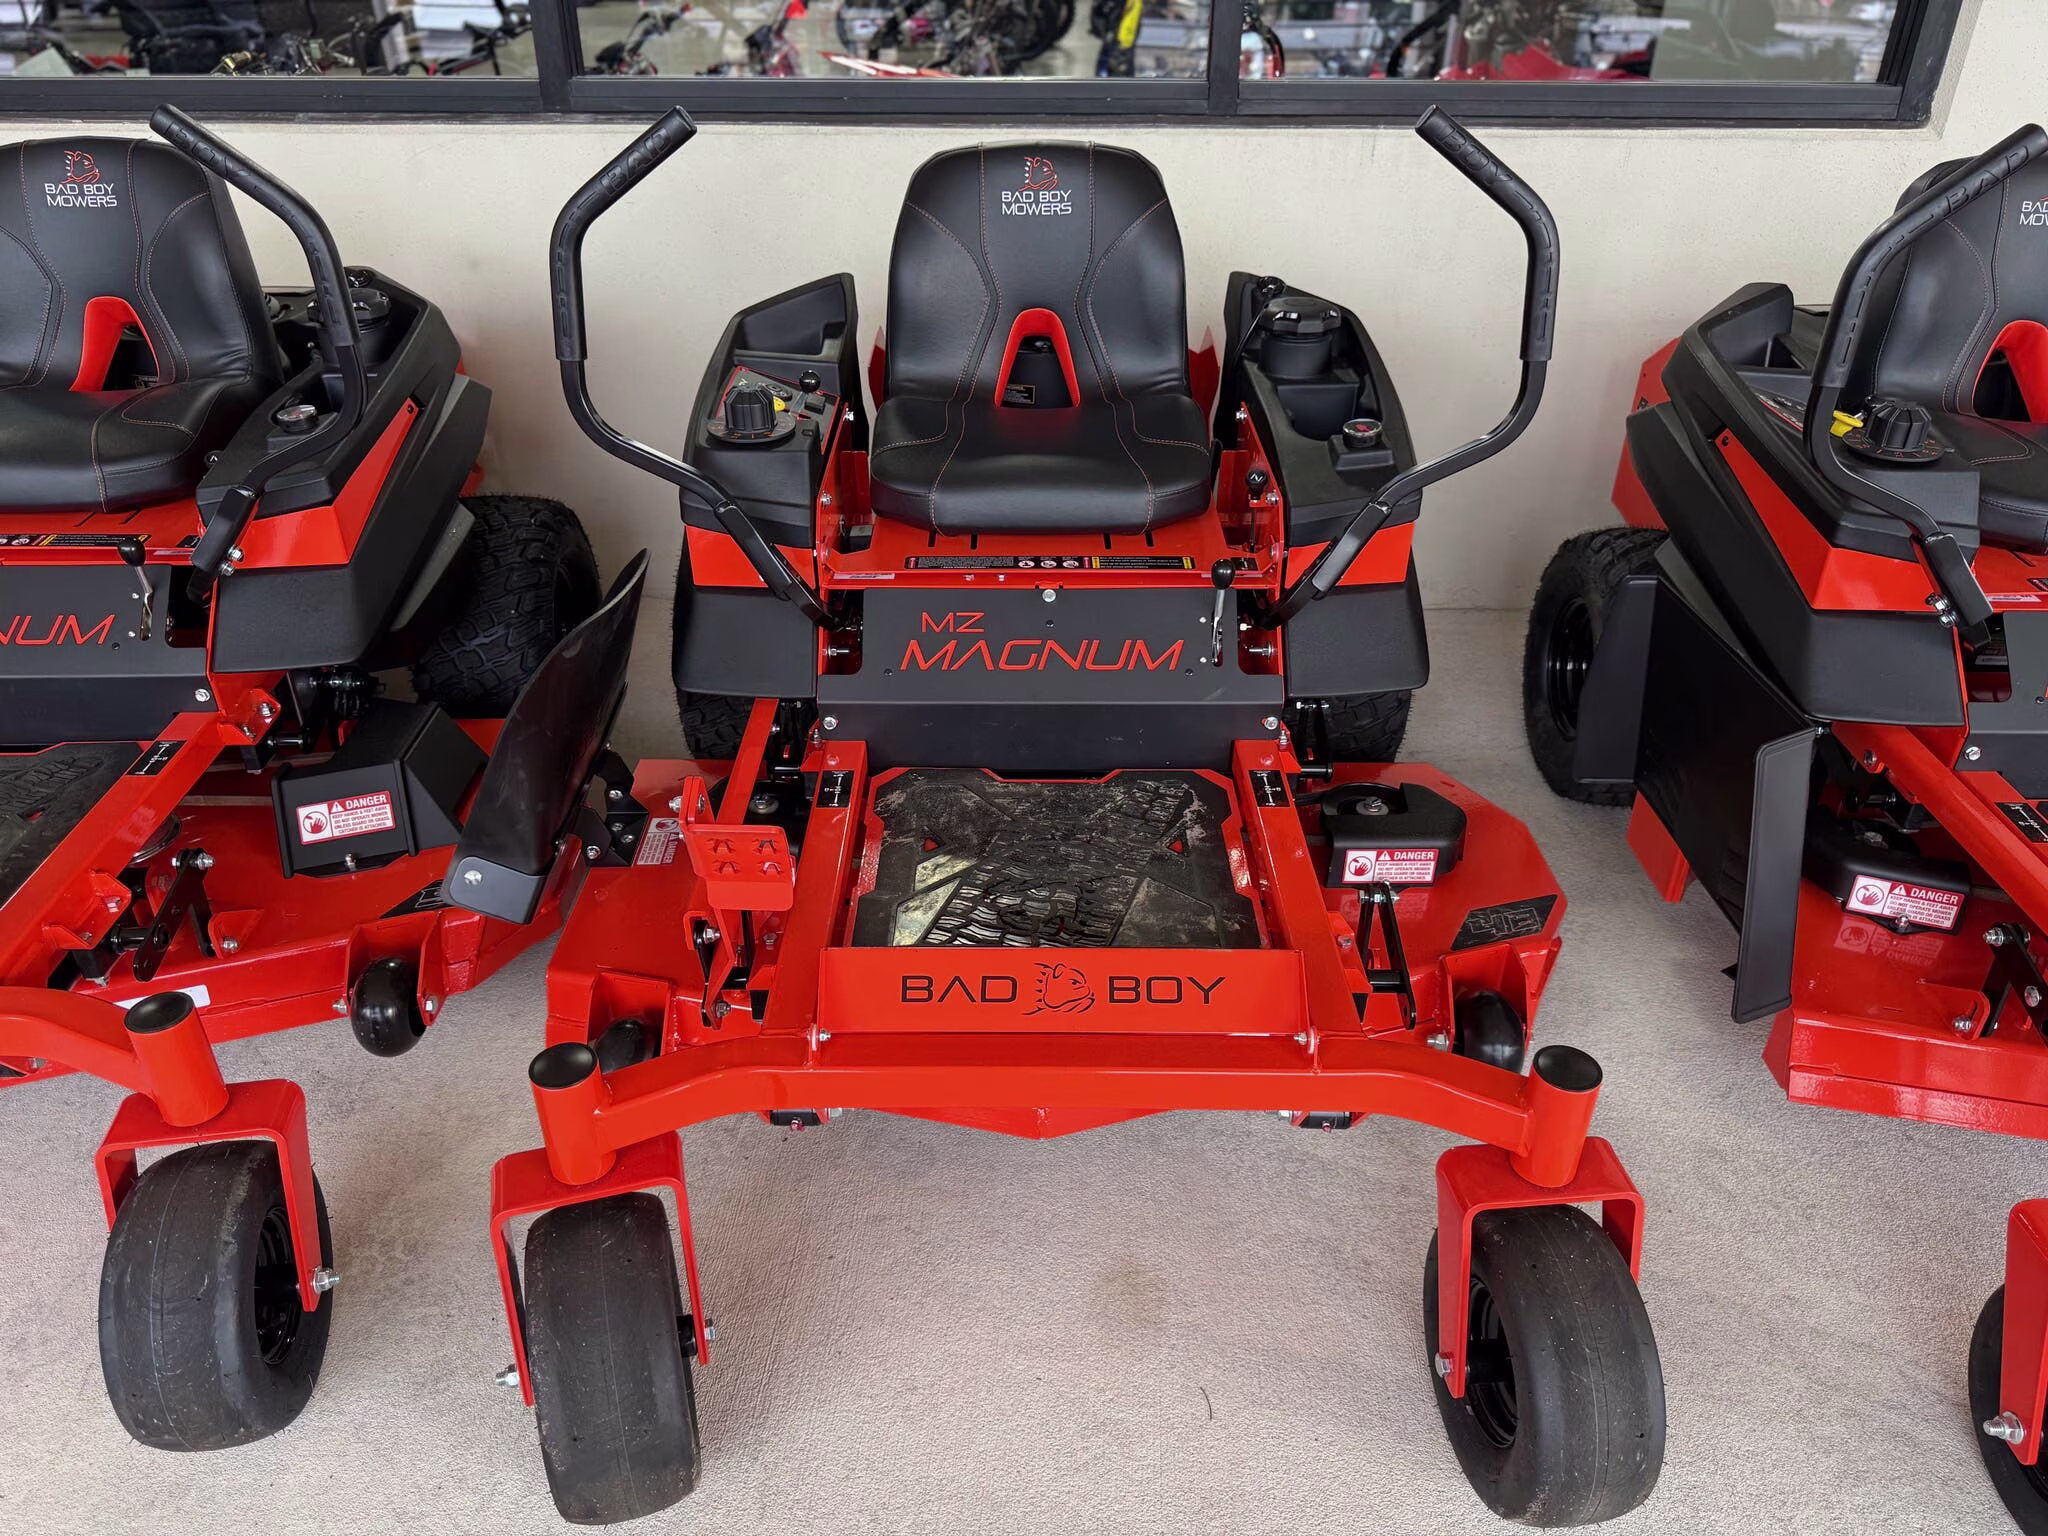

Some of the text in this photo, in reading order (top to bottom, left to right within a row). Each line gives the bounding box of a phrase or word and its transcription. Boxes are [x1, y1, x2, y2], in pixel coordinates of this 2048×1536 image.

[600, 127, 672, 196] BAD
[1440, 122, 1513, 186] BOY
[44, 183, 114, 195] BAD BOY
[1001, 189, 1072, 203] BAD BOY
[46, 195, 118, 207] MOWERS
[1001, 202, 1072, 216] MOWERS
[921, 612, 985, 633] MZ
[900, 639, 1185, 671] MAGNUM
[346, 795, 387, 809] DANGER
[1393, 852, 1434, 860] DANGER
[1911, 888, 1958, 904] DANGER
[901, 975, 1227, 1004] BAD BOY
